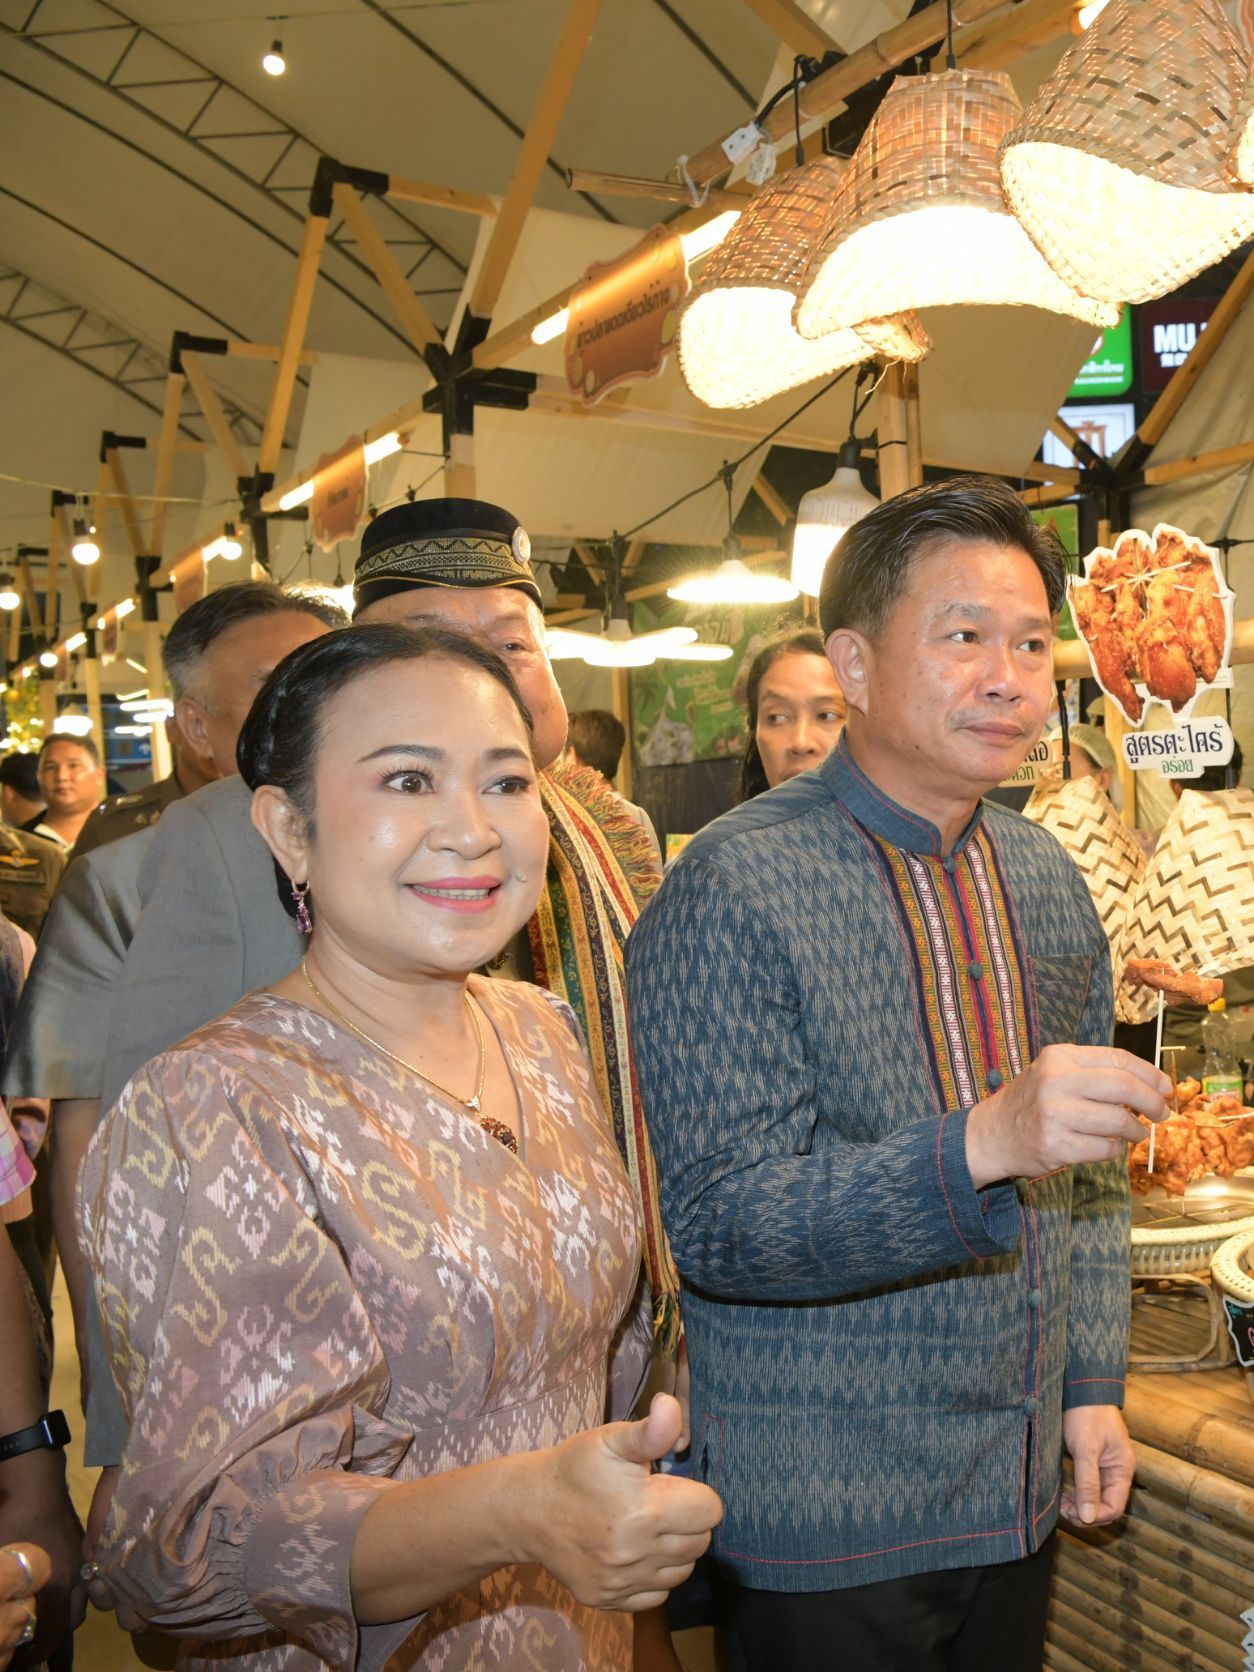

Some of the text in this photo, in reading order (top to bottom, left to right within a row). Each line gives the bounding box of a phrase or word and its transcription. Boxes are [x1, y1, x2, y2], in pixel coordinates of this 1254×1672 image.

[1125, 723, 1224, 764] สูตรตะไคร้
[1161, 755, 1194, 774] อร่อย
